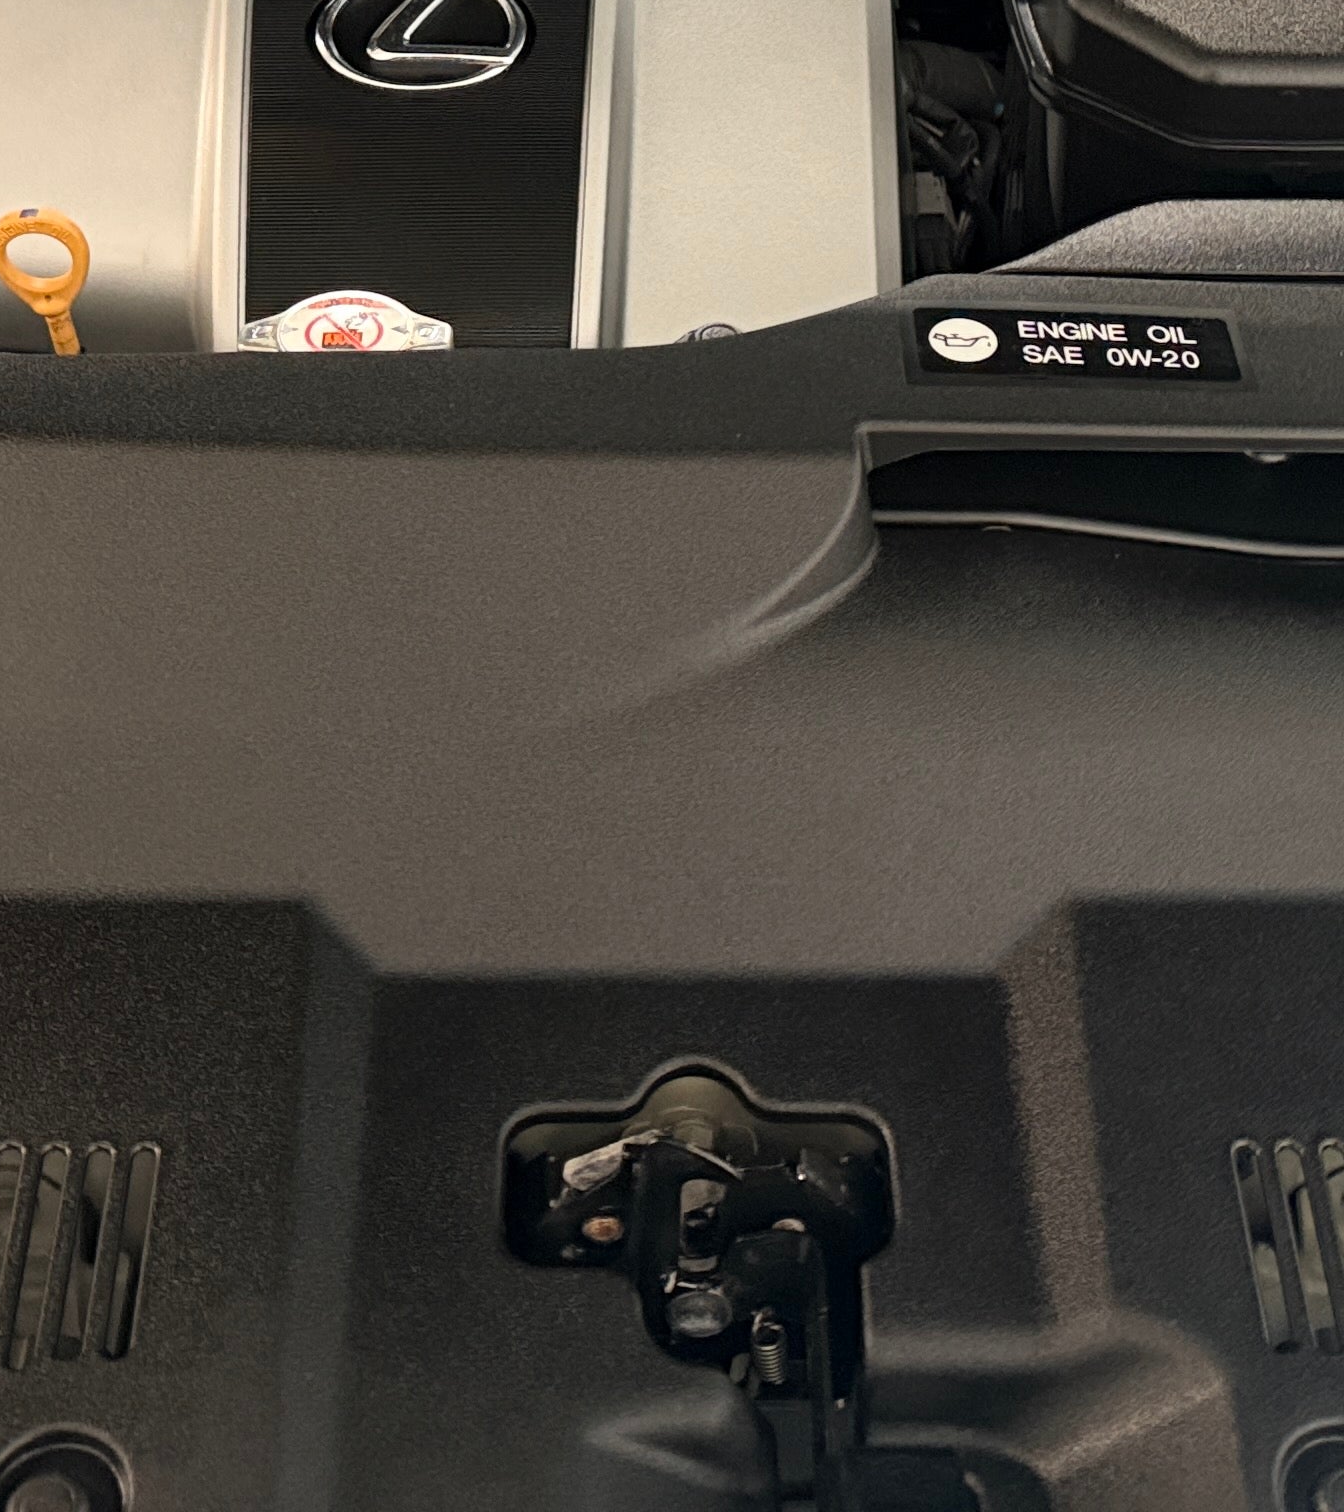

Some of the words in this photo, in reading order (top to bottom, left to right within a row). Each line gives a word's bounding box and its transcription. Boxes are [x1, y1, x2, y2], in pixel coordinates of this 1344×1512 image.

[1017, 319, 1128, 343] ENGINE
[1146, 324, 1198, 346] OIL
[1022, 344, 1085, 366] SAE
[1106, 347, 1201, 370] 0W-20
